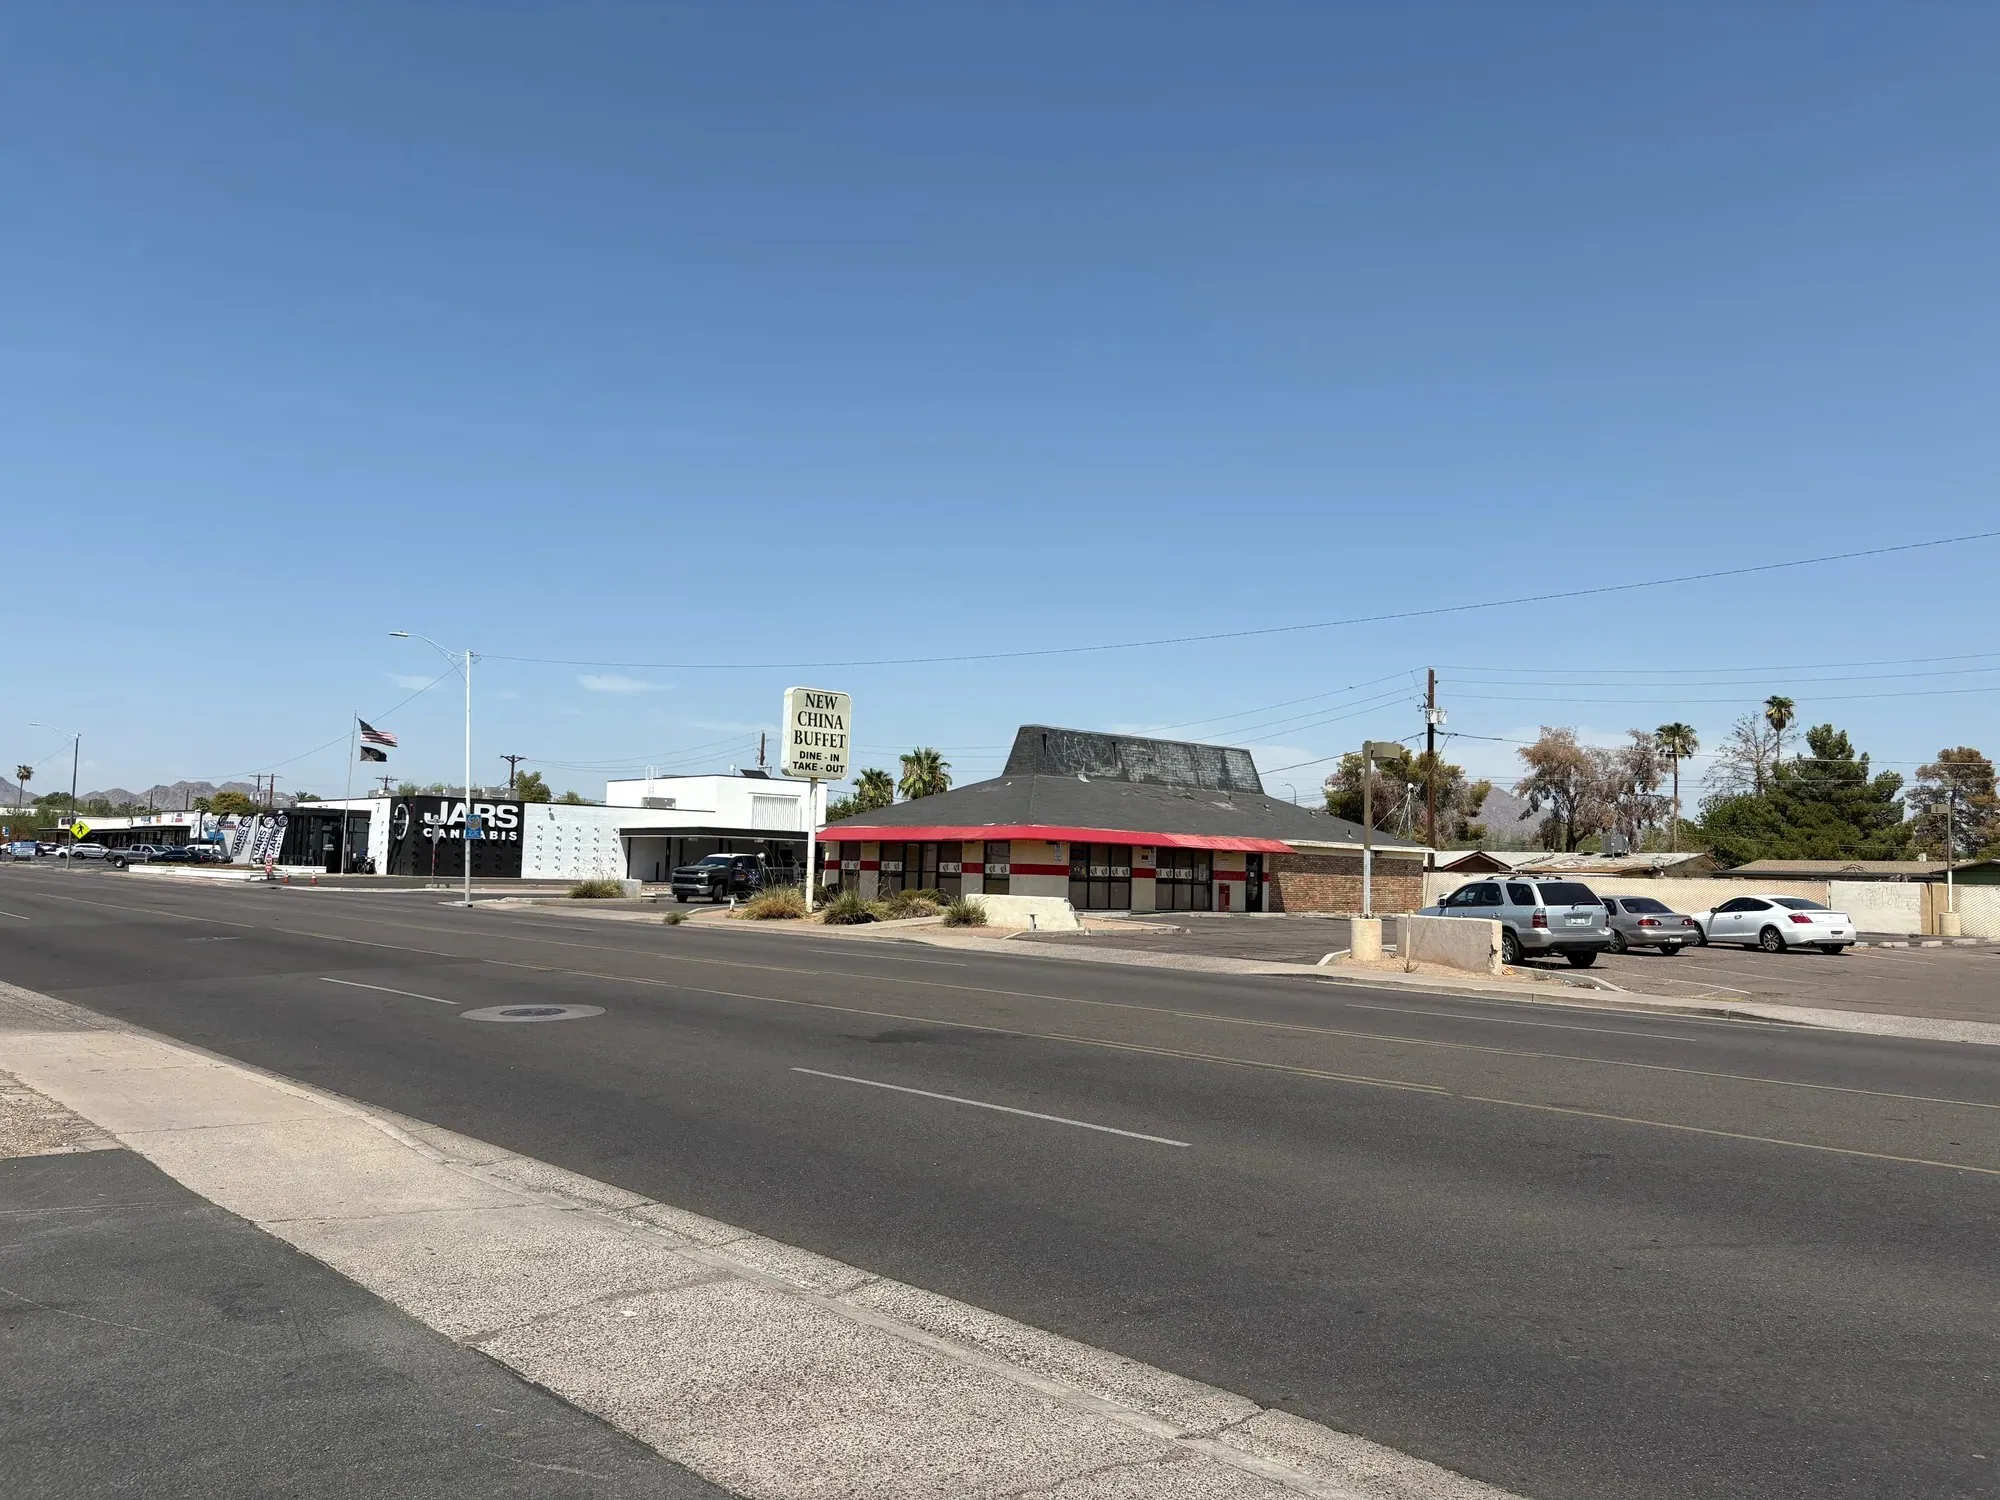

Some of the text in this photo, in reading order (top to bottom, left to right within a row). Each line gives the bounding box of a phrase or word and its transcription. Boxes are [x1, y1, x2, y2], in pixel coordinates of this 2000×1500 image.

[805, 693, 838, 710] NEW
[797, 710, 844, 730] CHINA
[794, 729, 846, 749] BUFFET
[799, 751, 822, 761] DINE
[830, 753, 840, 762] IN
[792, 761, 818, 771] TAKE
[826, 764, 845, 773] OUT
[424, 801, 519, 828] JARS
[234, 827, 246, 854] JARS
[253, 830, 267, 855] JARS
[268, 829, 280, 855] JARS
[423, 828, 517, 840] CANABIS
